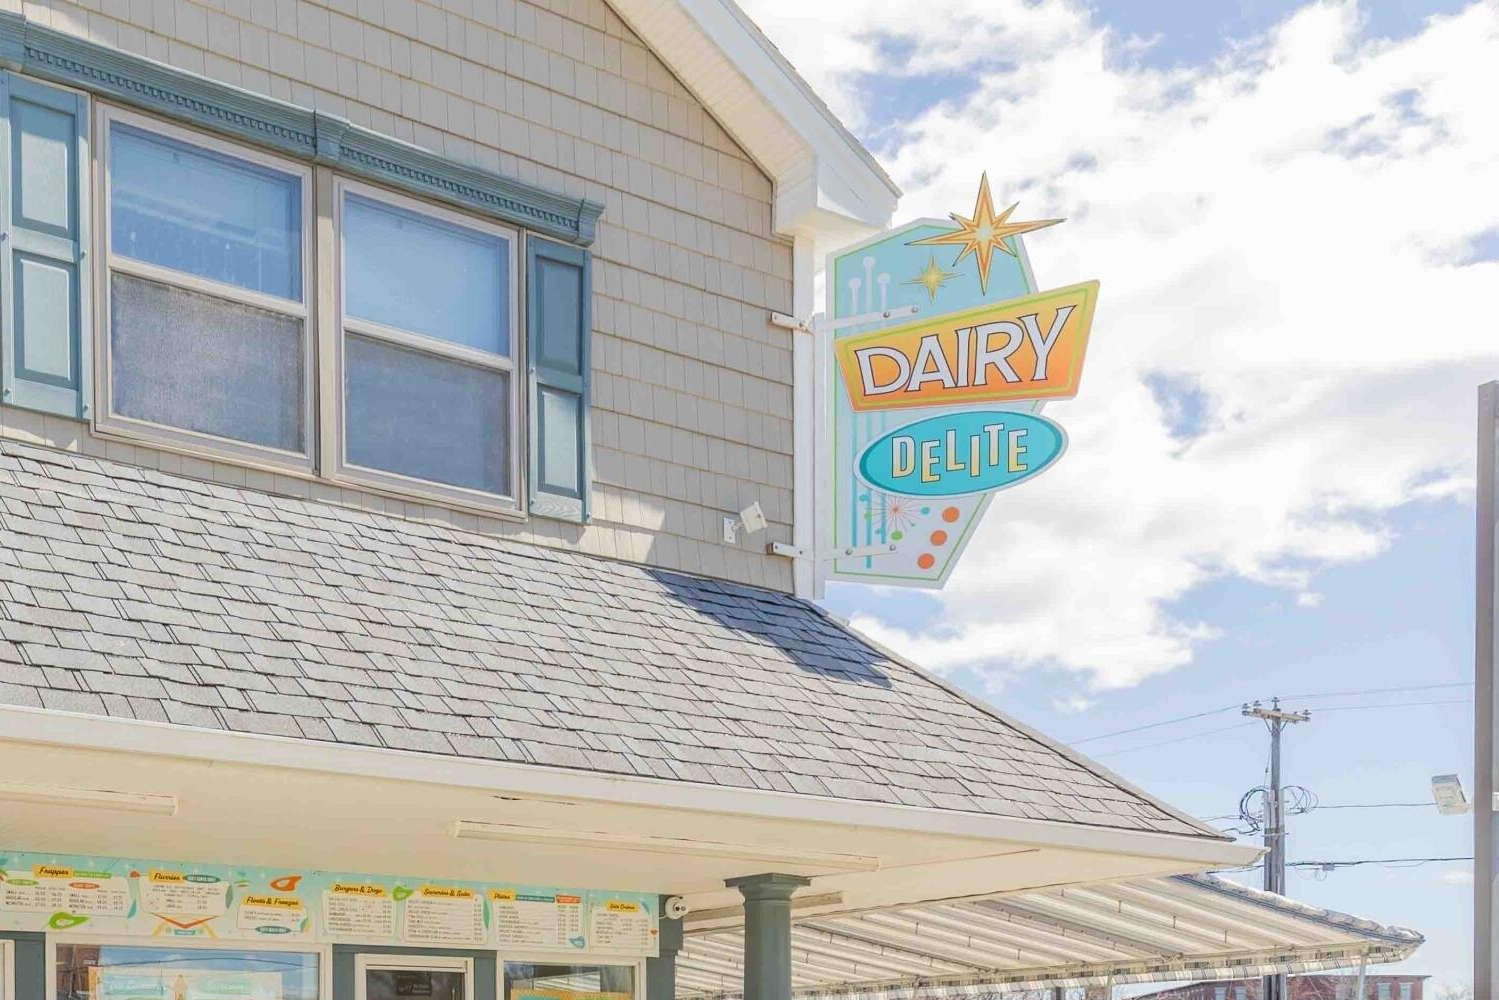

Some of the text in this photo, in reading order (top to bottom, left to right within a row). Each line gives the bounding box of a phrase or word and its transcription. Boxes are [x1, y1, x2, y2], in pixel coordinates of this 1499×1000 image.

[853, 304, 1077, 397] DAIRY
[891, 422, 1029, 484] DELITE
[39, 866, 69, 876] Frappes
[334, 884, 359, 895] Burgers
